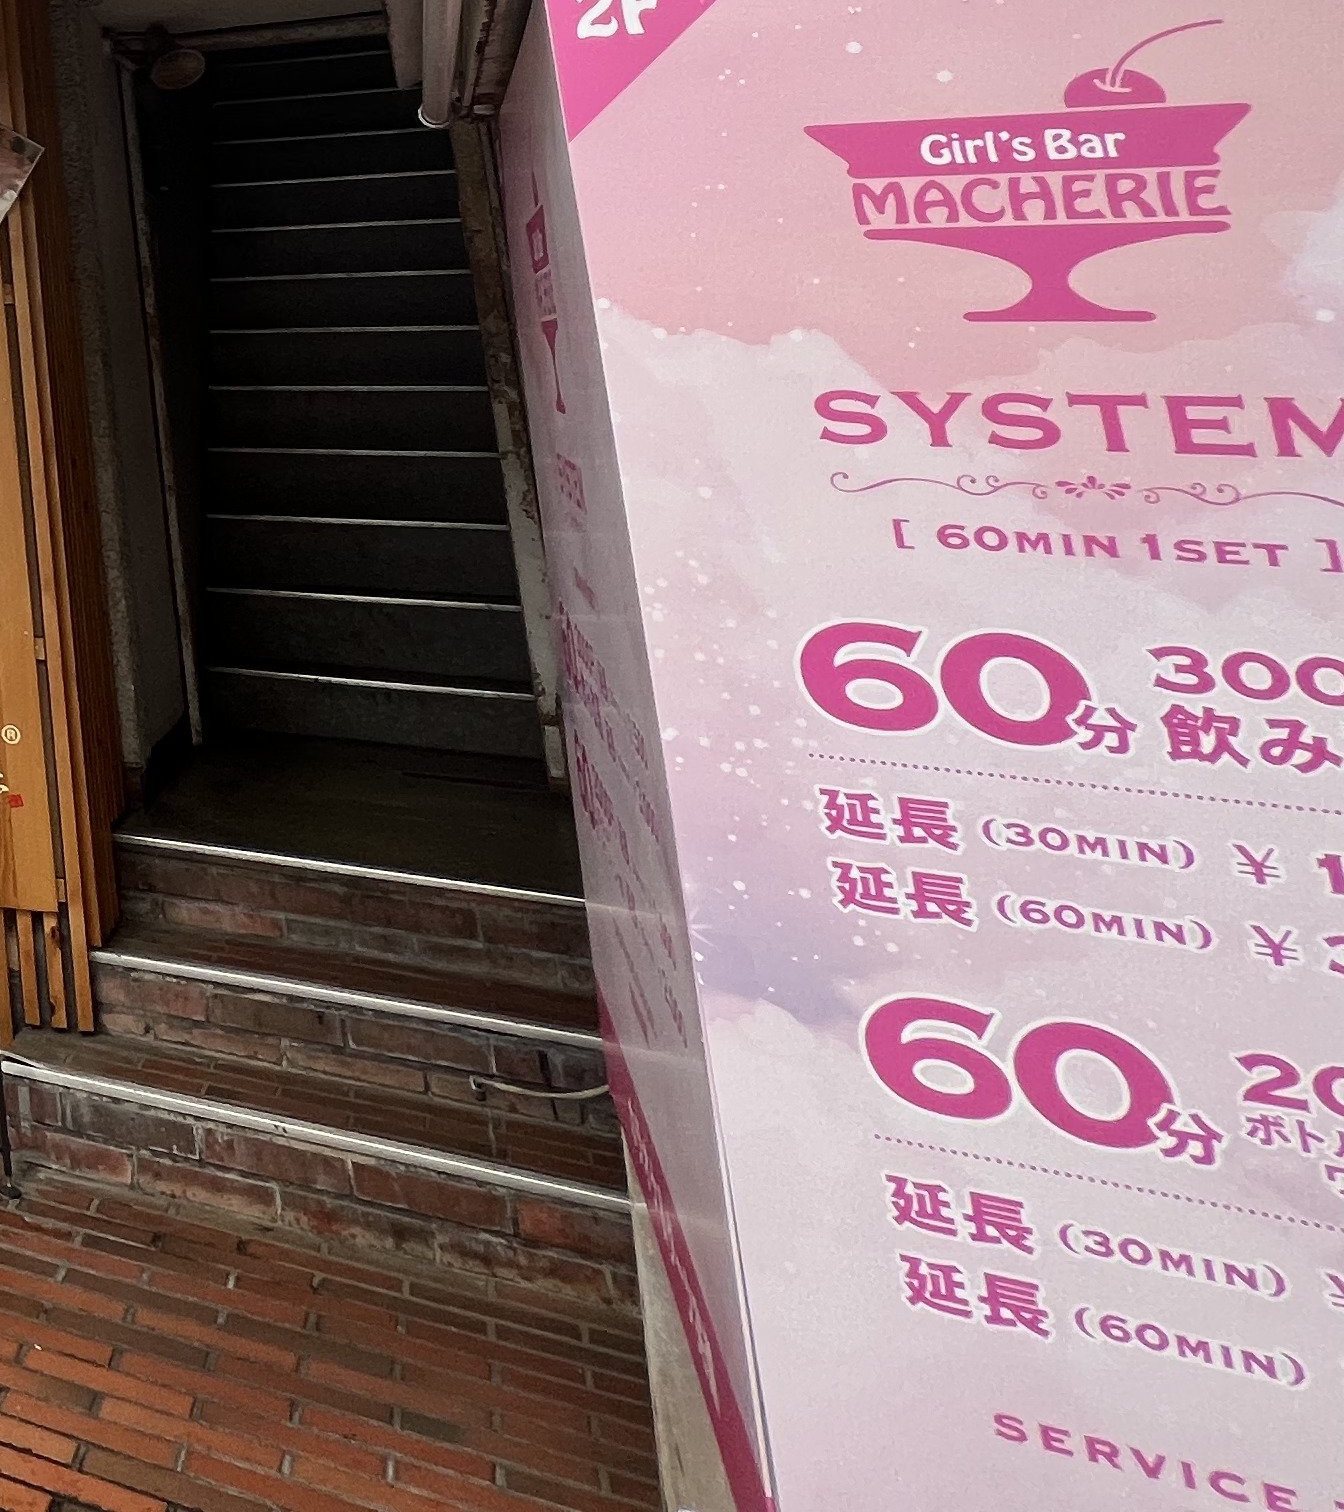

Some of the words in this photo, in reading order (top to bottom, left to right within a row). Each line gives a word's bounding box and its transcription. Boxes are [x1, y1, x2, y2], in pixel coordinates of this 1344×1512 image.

[920, 130, 1037, 168] Girl's
[1045, 129, 1124, 162] Bar
[852, 169, 1232, 226] MACHERIE
[937, 524, 1120, 561] 60MIN
[1140, 537, 1289, 572] 1SET
[818, 789, 959, 851] 延長
[832, 861, 974, 928] 延長
[886, 1174, 1033, 1254] 延長
[900, 1254, 1050, 1339] 延長
[994, 1413, 1298, 1512] SERVICE
